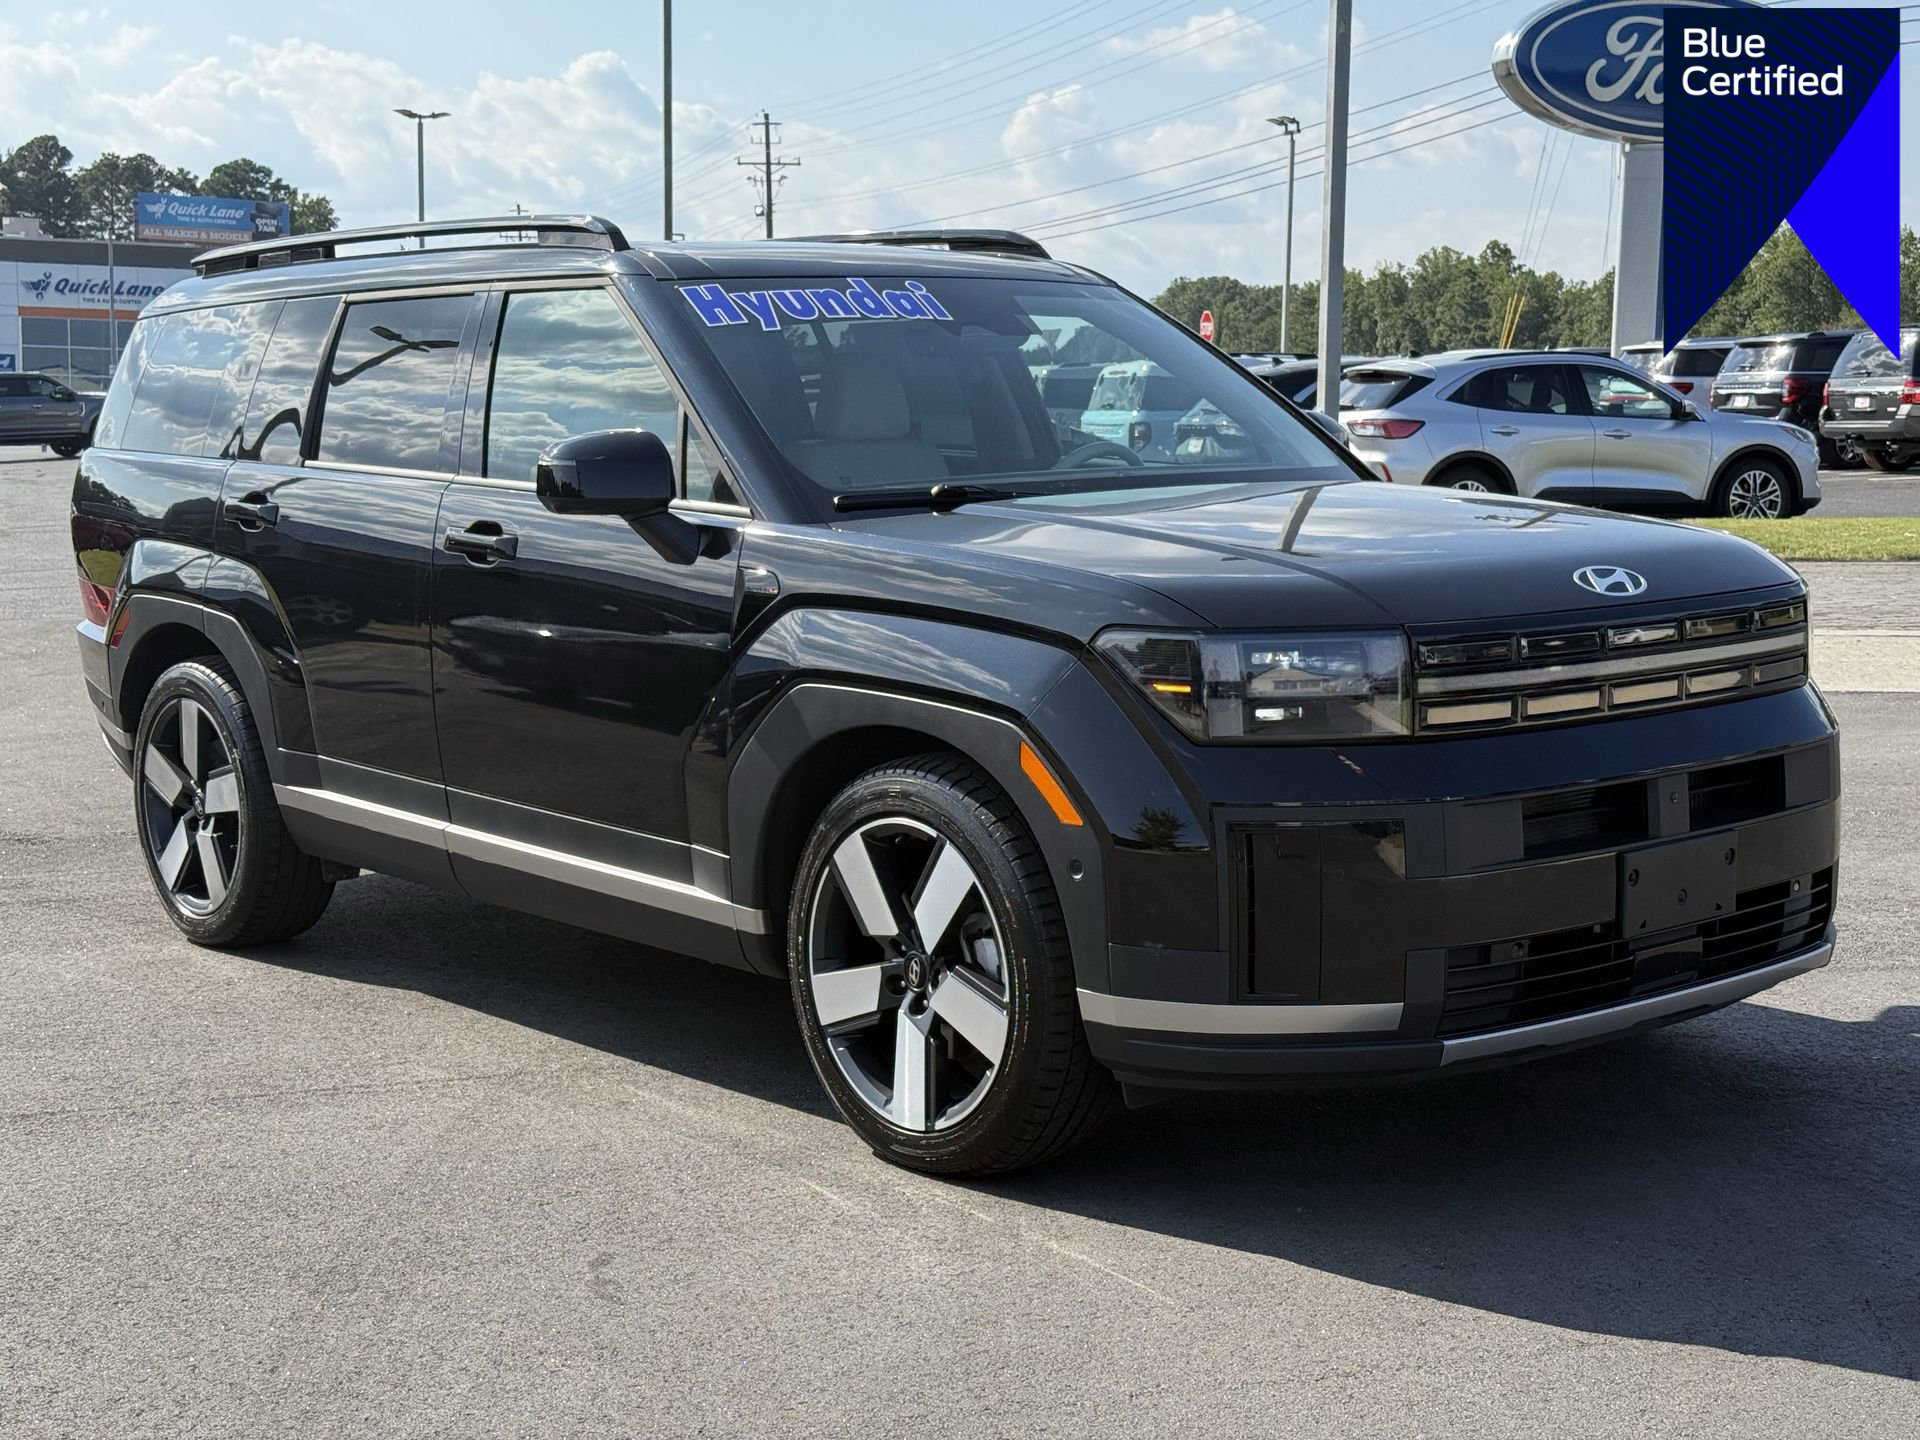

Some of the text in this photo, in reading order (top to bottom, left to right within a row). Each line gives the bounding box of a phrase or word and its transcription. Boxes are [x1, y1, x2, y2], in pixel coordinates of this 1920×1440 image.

[167, 202, 245, 218] Quick Lane
[255, 218, 278, 226] OPEN
[143, 228, 162, 236] ALL
[164, 229, 198, 238] MAKES
[210, 231, 250, 241] MODELS
[54, 277, 165, 297] Quick Lane
[679, 277, 953, 331] Hyundai
